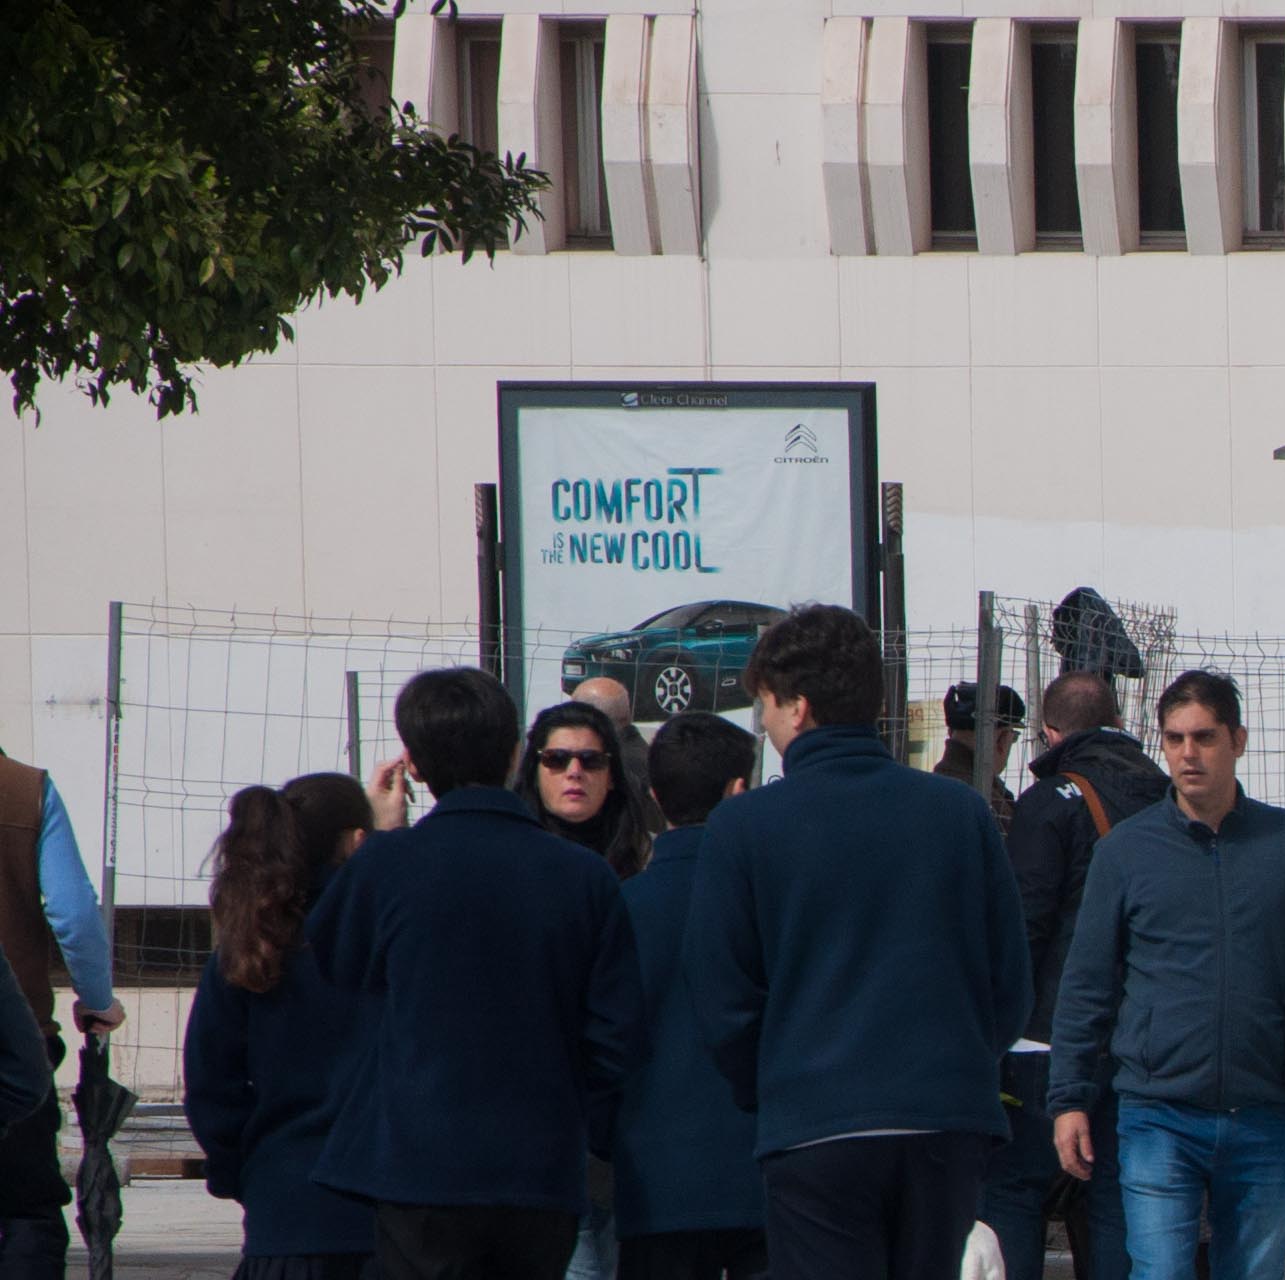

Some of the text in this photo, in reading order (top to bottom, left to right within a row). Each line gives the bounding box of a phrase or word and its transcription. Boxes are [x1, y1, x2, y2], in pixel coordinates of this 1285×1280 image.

[641, 393, 728, 406] Clear Channel
[552, 467, 722, 524] COMFORT
[541, 529, 722, 573] THE NEW COOL
[553, 532, 565, 549] IS
